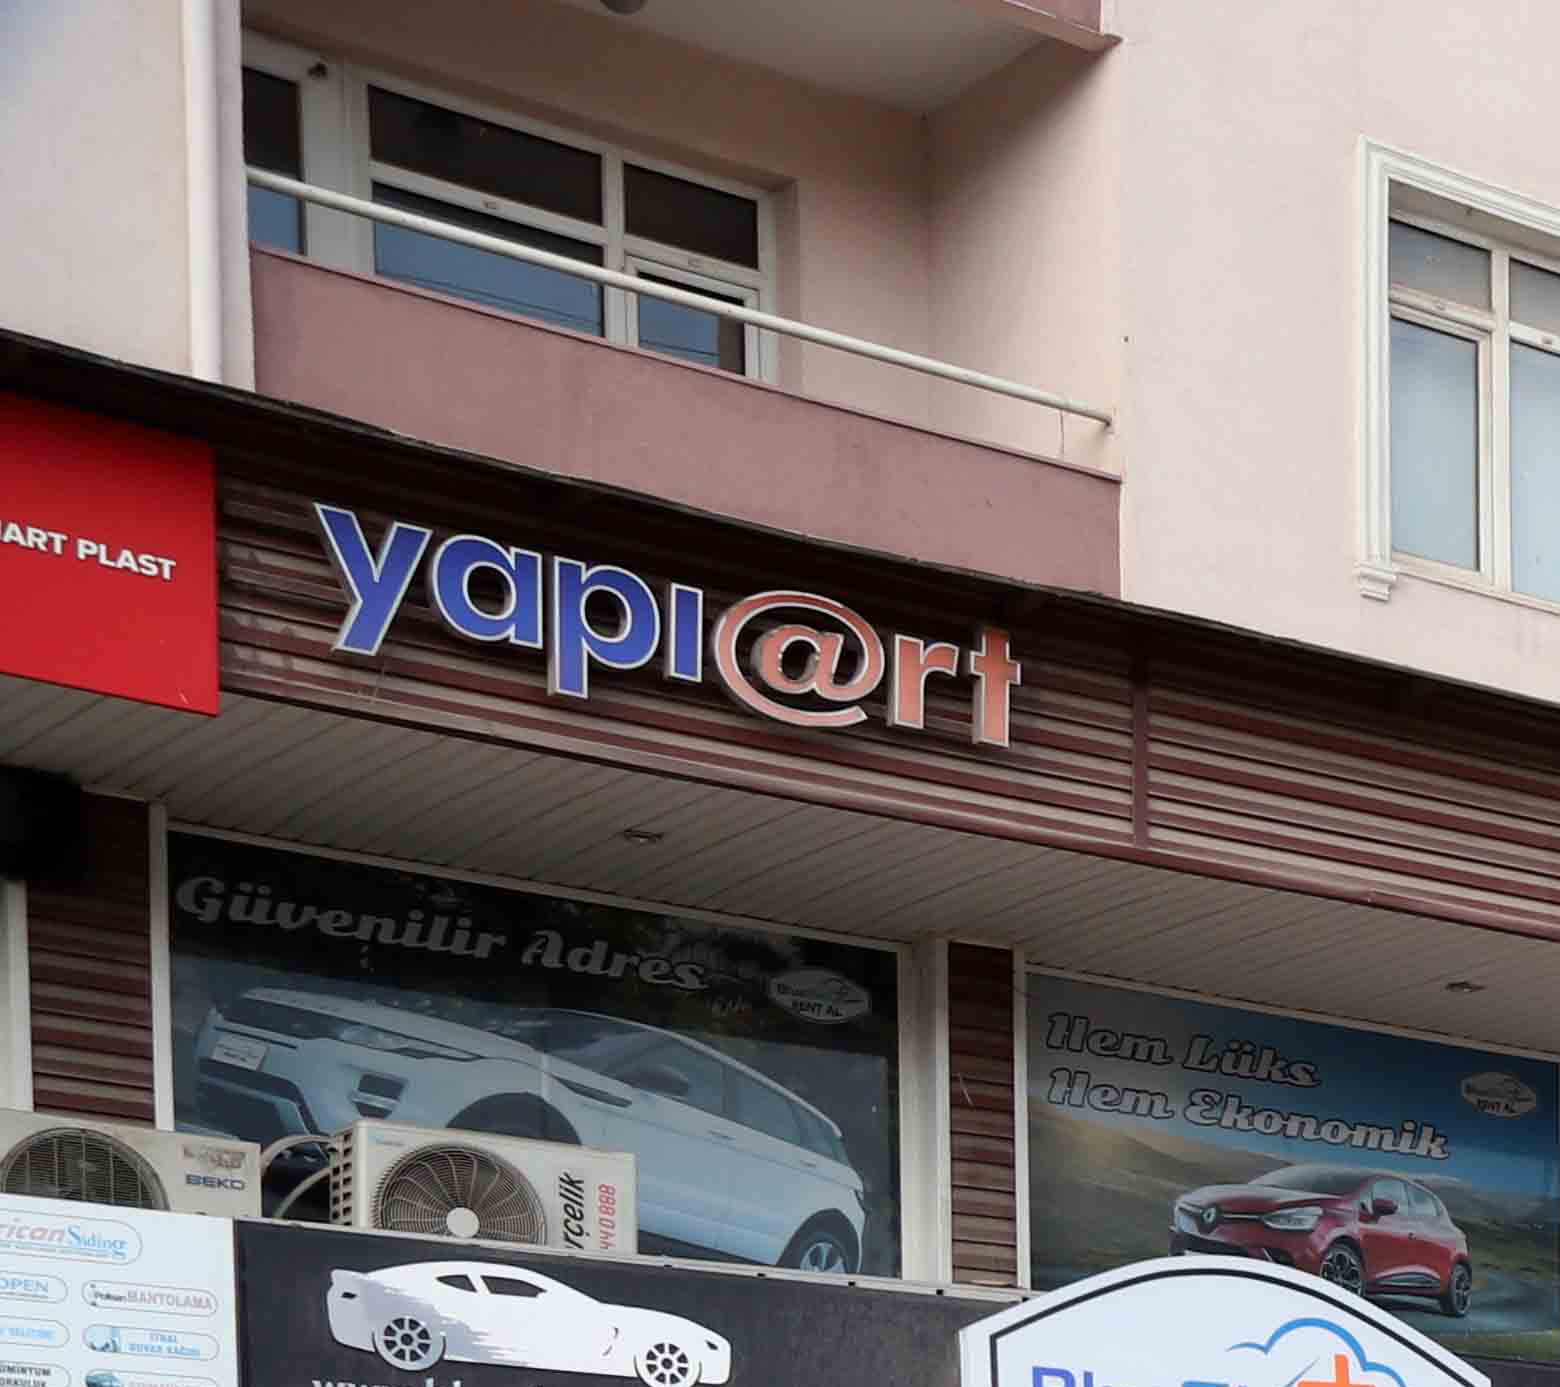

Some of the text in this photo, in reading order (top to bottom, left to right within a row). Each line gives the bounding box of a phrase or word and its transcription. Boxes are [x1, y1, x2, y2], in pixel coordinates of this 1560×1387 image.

[0, 520, 177, 580] ART PLAST
[175, 876, 708, 993] Güvenilir Adres
[1046, 1012, 1321, 1089] Hem Lüks
[1046, 1067, 1450, 1160] Hem Ekonomik
[185, 1172, 245, 1191] BEKO
[559, 1171, 590, 1250] rçelik
